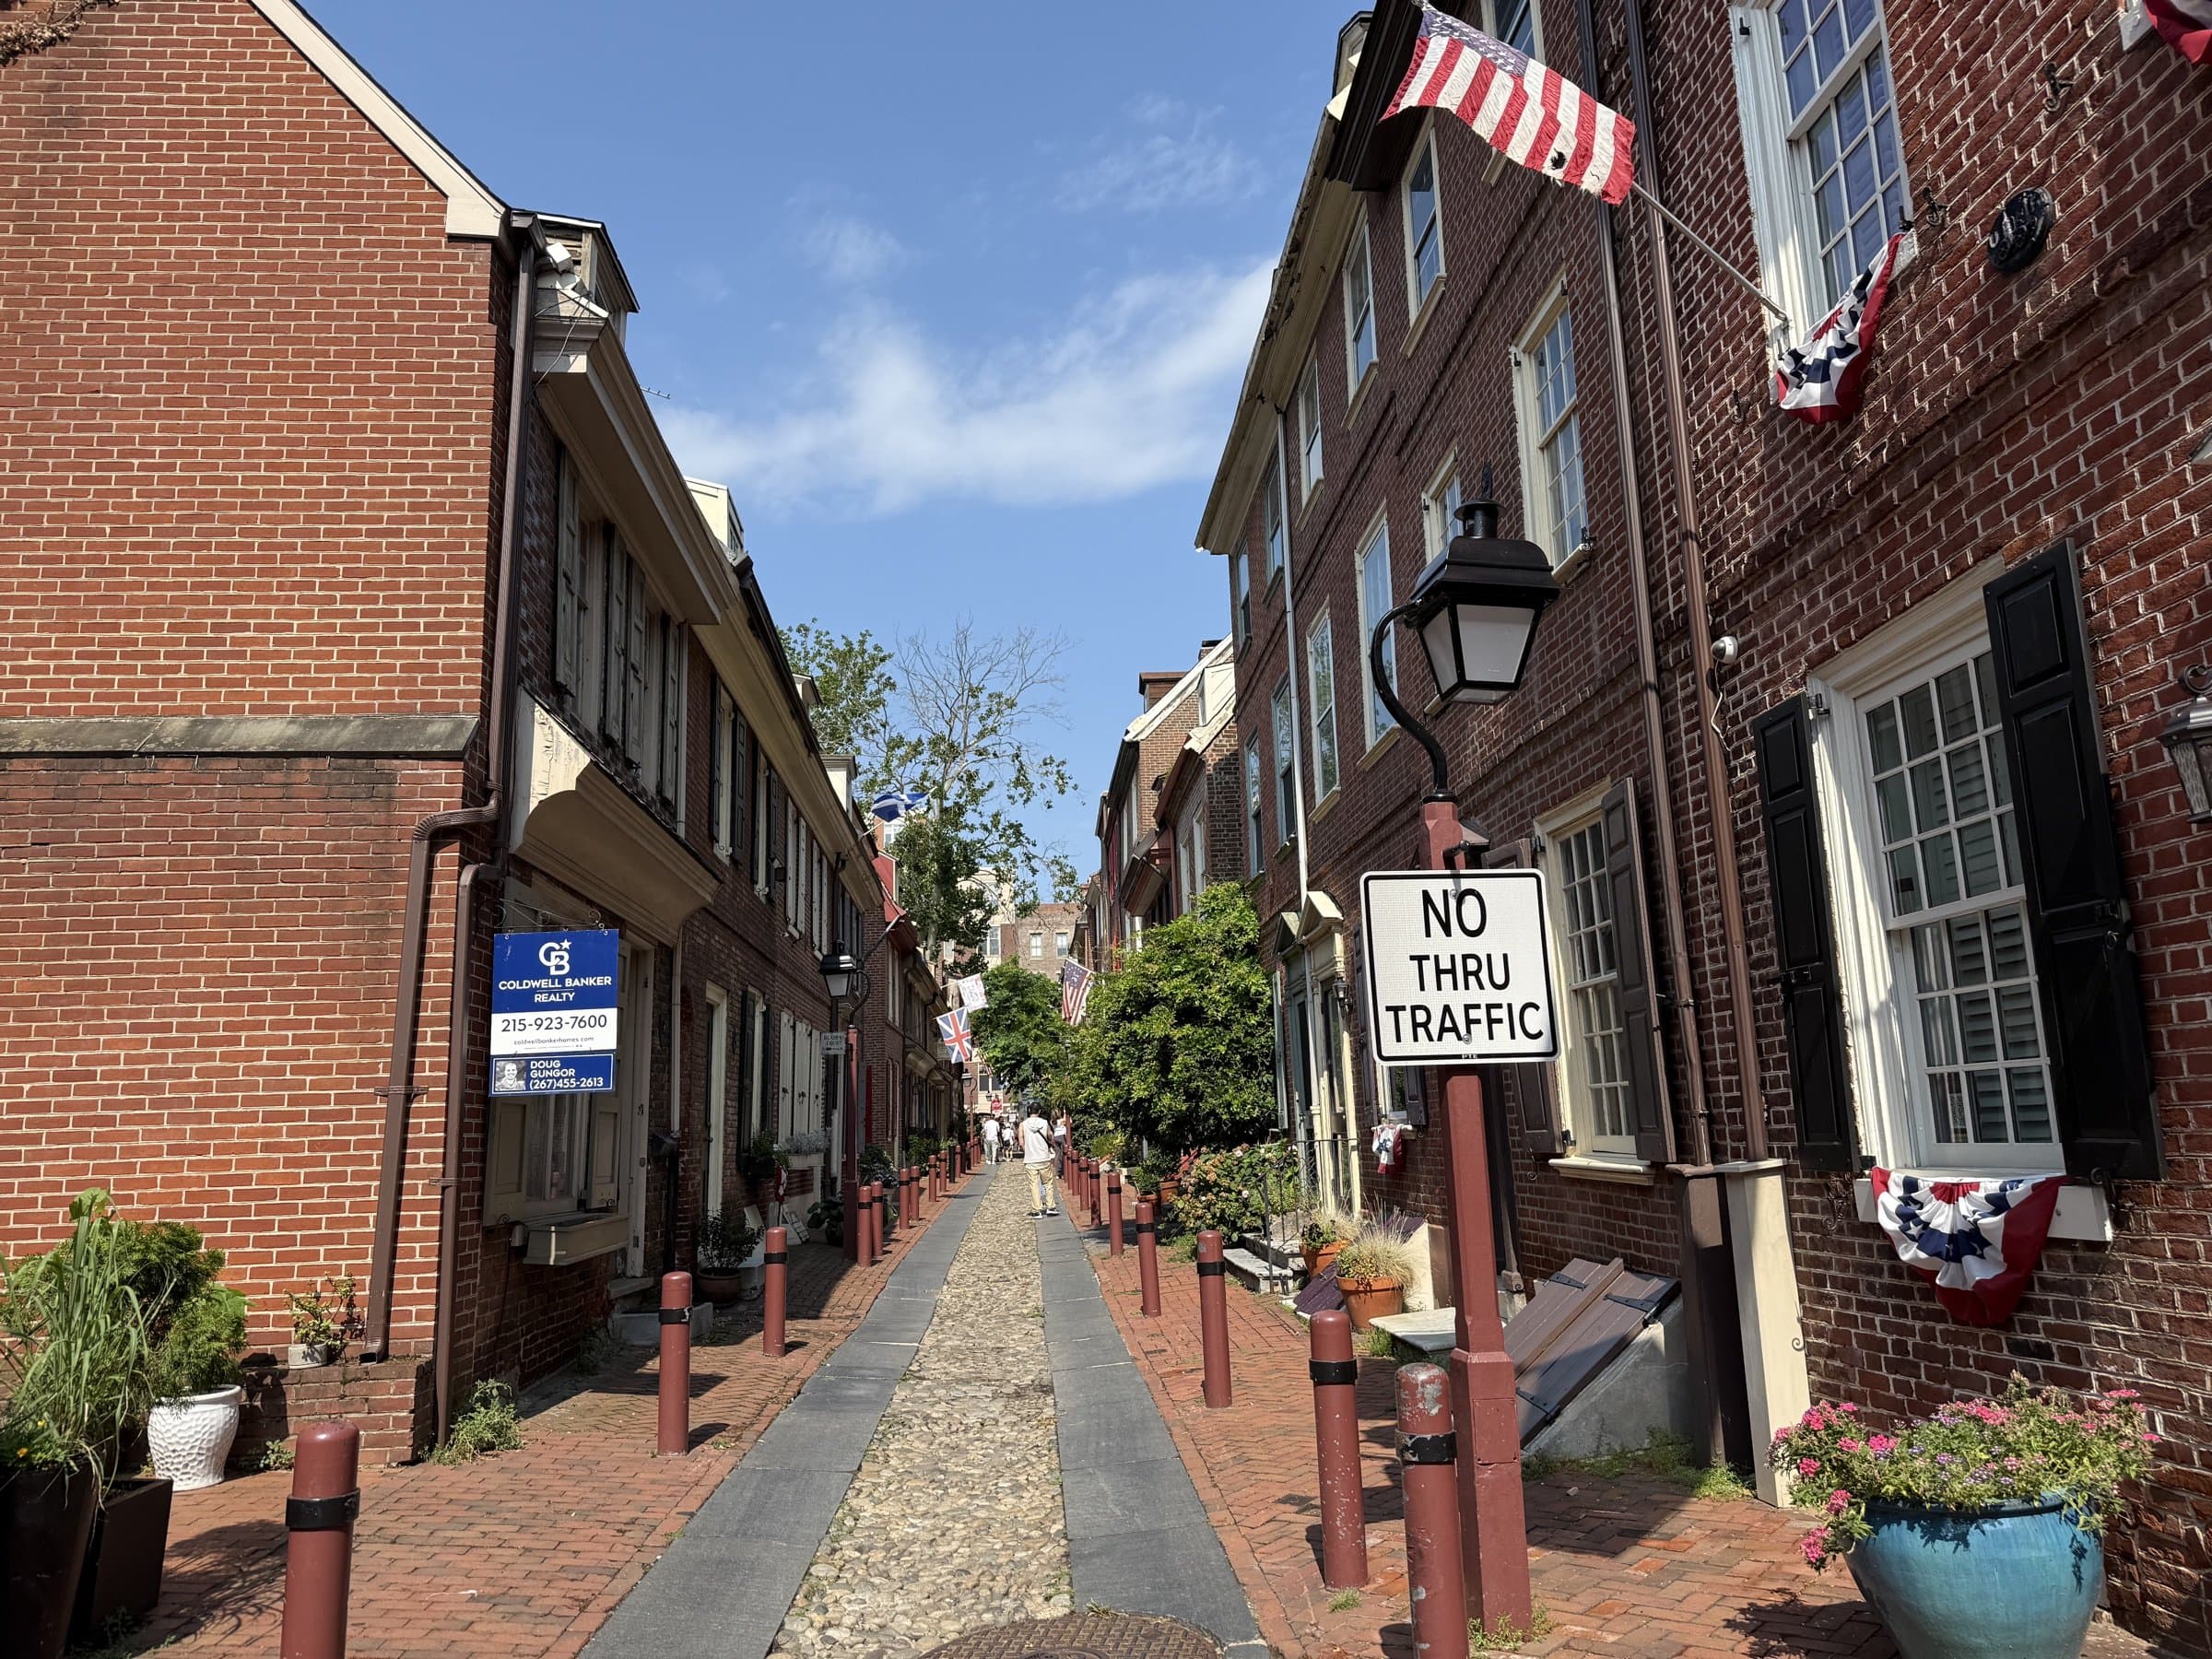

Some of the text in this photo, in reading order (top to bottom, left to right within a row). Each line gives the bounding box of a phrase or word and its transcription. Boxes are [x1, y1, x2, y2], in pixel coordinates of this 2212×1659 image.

[1422, 888, 1487, 937] NO
[1409, 953, 1511, 992] THRU
[499, 976, 612, 991] COLDWELL BANKER
[534, 993, 576, 1003] REALTY
[501, 1014, 607, 1032] 215-923-7600
[1385, 1002, 1544, 1042] TRAFFIC
[513, 1036, 594, 1045] coldwellbankerhomescom
[530, 1060, 561, 1069] DOUG
[530, 1069, 576, 1078] GUNGOR
[530, 1077, 604, 1090] (267)455-2613
